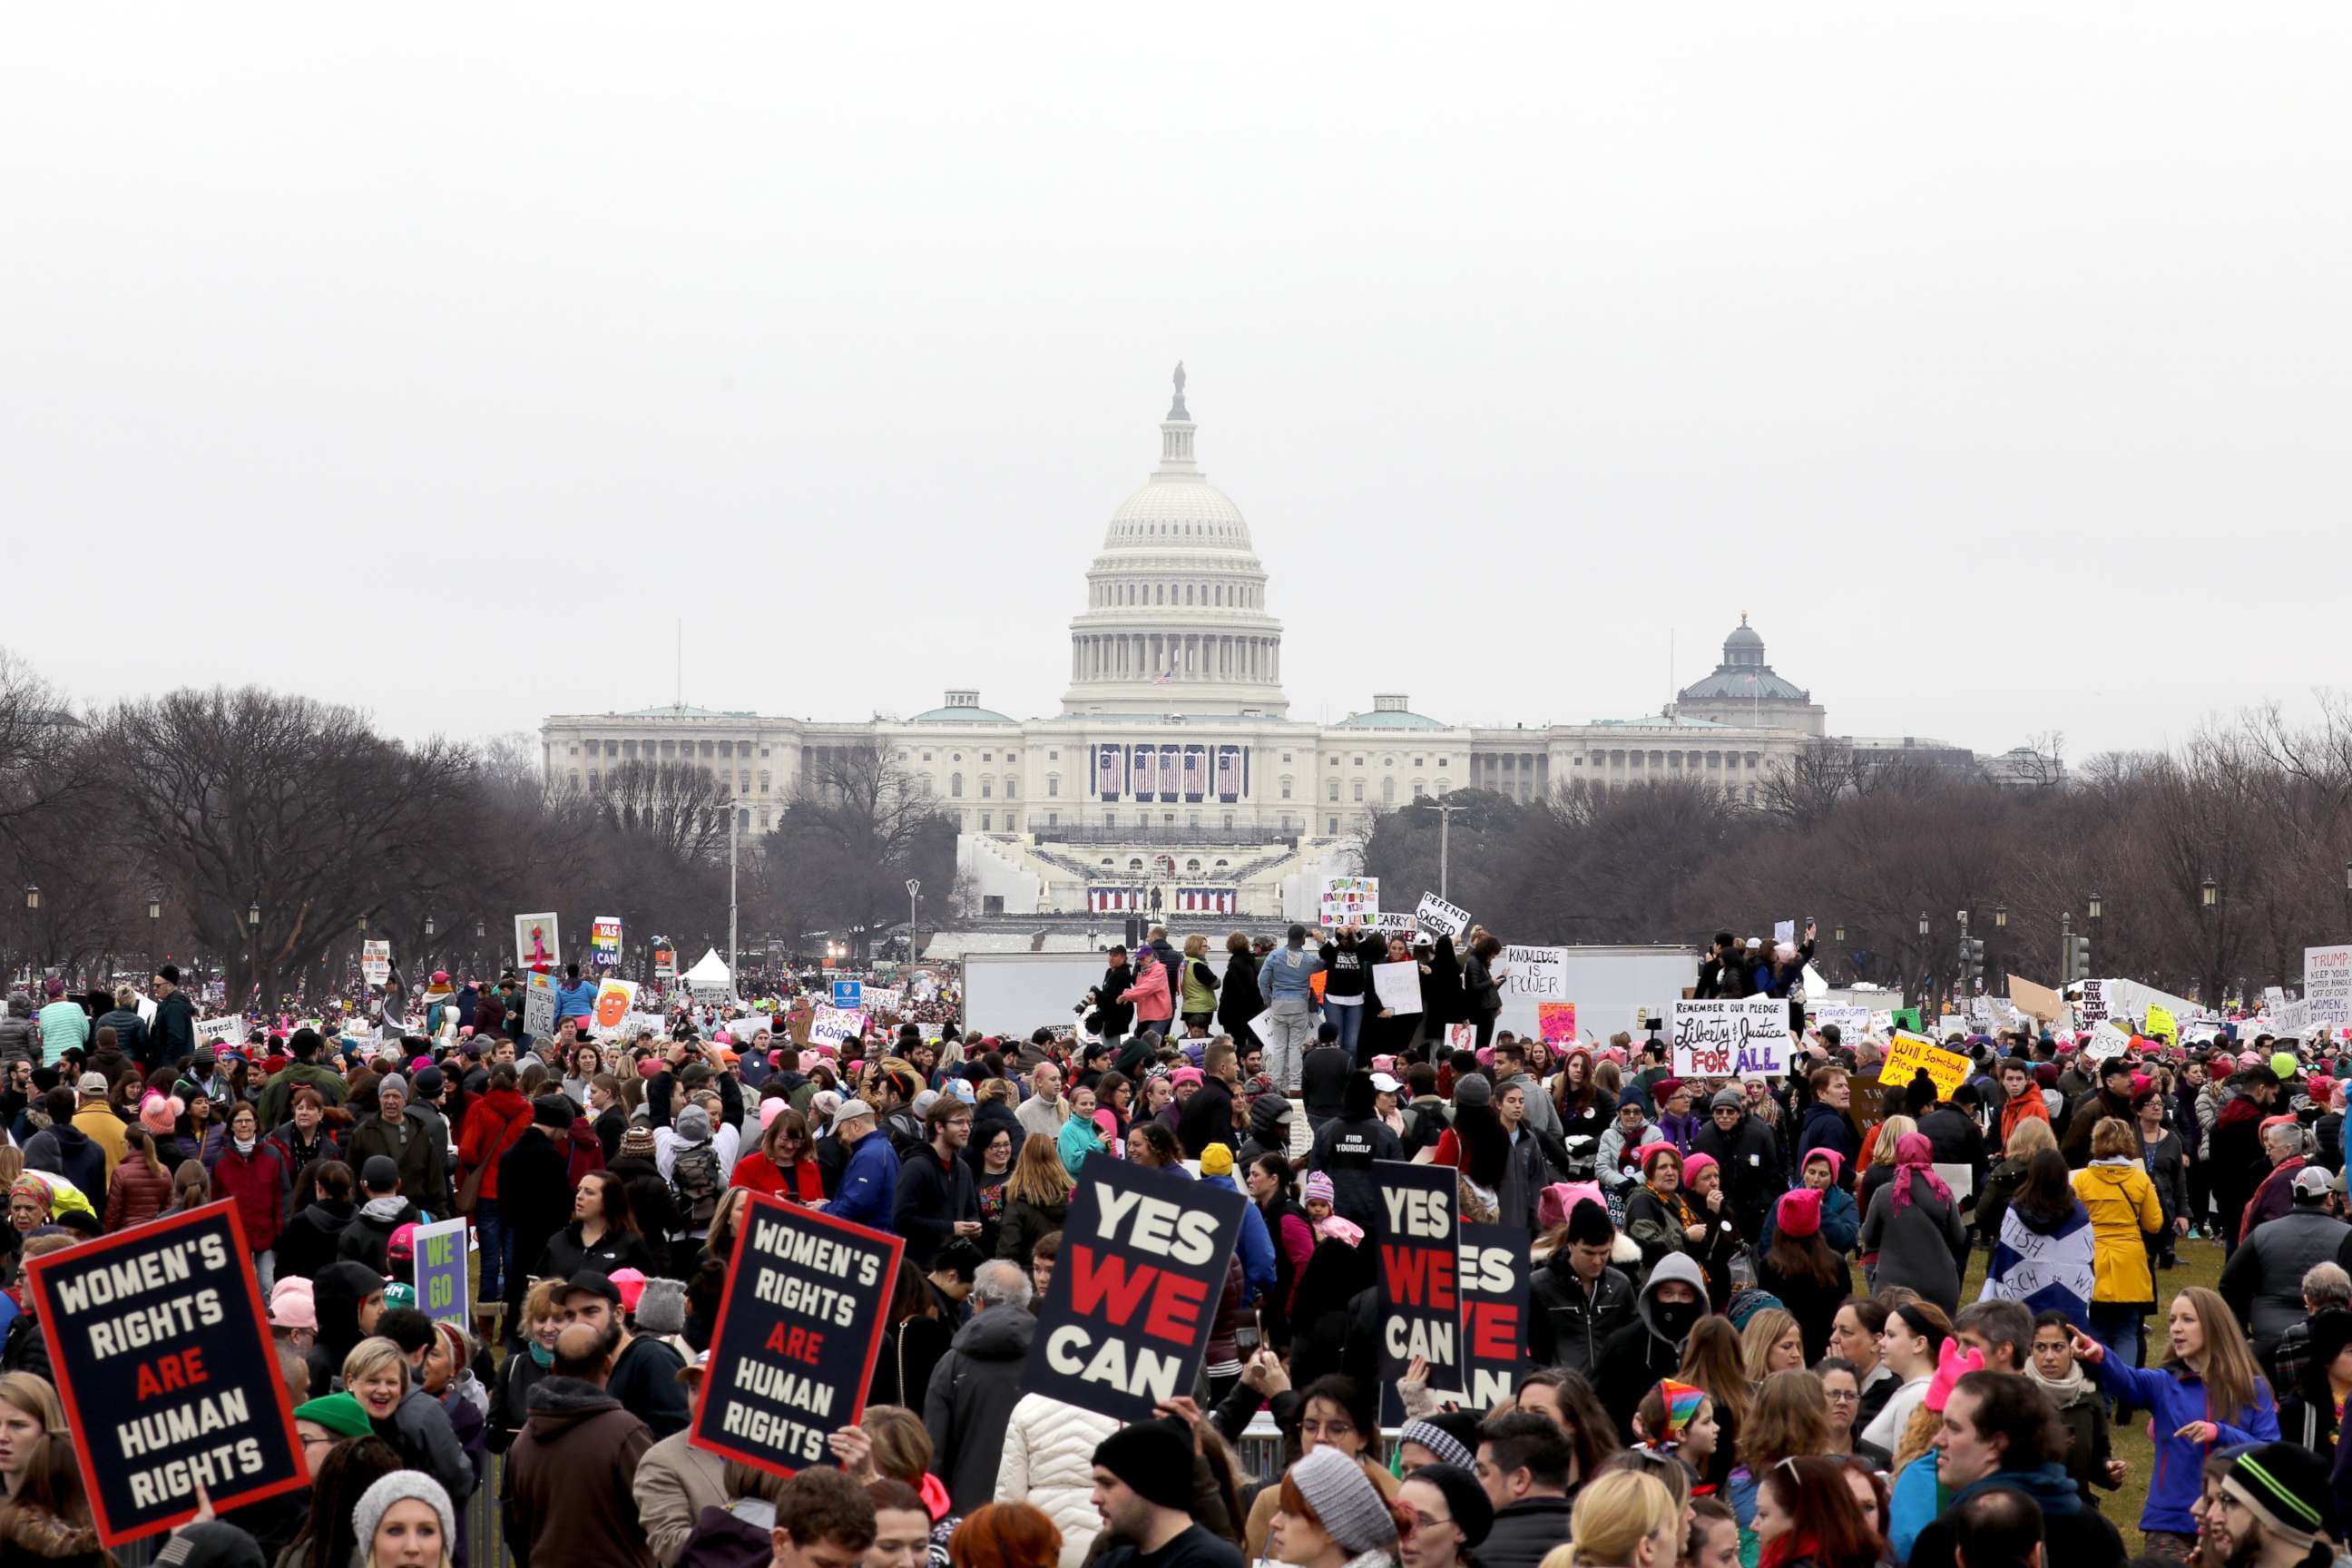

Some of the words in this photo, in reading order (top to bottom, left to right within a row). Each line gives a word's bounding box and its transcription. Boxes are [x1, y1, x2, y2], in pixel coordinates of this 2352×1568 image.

[1378, 914, 1407, 926] CARRY
[1424, 893, 1468, 922] DEFEND
[600, 926, 618, 936] YAS
[1416, 909, 1455, 936] SACRED
[597, 953, 618, 965] CAN
[600, 939, 615, 951] WE
[1509, 948, 1560, 964] KNOWLEDGE
[1509, 975, 1560, 994] POWER
[1529, 965, 1540, 976] IS
[2310, 970, 2329, 979] KEEP
[2332, 969, 2349, 978] YOUR
[2084, 981, 2102, 991] KEEP
[2084, 992, 2101, 1001] YOUR
[2312, 990, 2325, 998] OFF
[2325, 989, 2333, 997] OF
[2334, 988, 2348, 996] OUR
[535, 1004, 547, 1015] WE
[1676, 1004, 1724, 1014] REMEMBER
[1730, 1004, 1744, 1013] OUR
[1749, 1004, 1783, 1014] PLEDGE:
[2082, 1011, 2108, 1020] HANDS
[2083, 1001, 2106, 1010] TINY
[2310, 1011, 2348, 1024] RIGHTS!
[529, 1012, 550, 1033] RISE
[1674, 1015, 1731, 1052] Liberty
[1738, 1017, 1787, 1049] Justice
[1691, 1050, 1730, 1073] FOR
[1737, 1047, 1780, 1073] ALL
[1890, 1055, 1914, 1072] Plea
[1894, 1041, 1921, 1060] Will
[1924, 1050, 1965, 1073] Somebody
[1336, 1143, 1372, 1153] YOURSELF
[1345, 1134, 1362, 1143] FIND
[1608, 1193, 1622, 1203] DO
[1094, 1181, 1220, 1266] YES
[1380, 1186, 1450, 1240] YES
[426, 1233, 454, 1268] WE
[753, 1218, 880, 1287] WOMEN'S
[56, 1233, 227, 1315] WOMEN'S
[1380, 1244, 1455, 1311] WE
[1458, 1244, 1515, 1294] ES
[429, 1273, 452, 1308] GO
[754, 1267, 857, 1328] RIGHTS
[1072, 1243, 1209, 1347] WE
[2001, 1269, 2040, 1301] ARCH
[88, 1288, 223, 1360] RIGHTS
[765, 1320, 825, 1365] ARE
[1386, 1315, 1454, 1366] CAN
[138, 1346, 209, 1401] ARE
[1046, 1324, 1182, 1406] CAN
[734, 1356, 835, 1417] HUMAN
[117, 1387, 250, 1459] HUMAN
[722, 1400, 825, 1462] RIGHTS
[129, 1436, 264, 1509] RIGHTS
